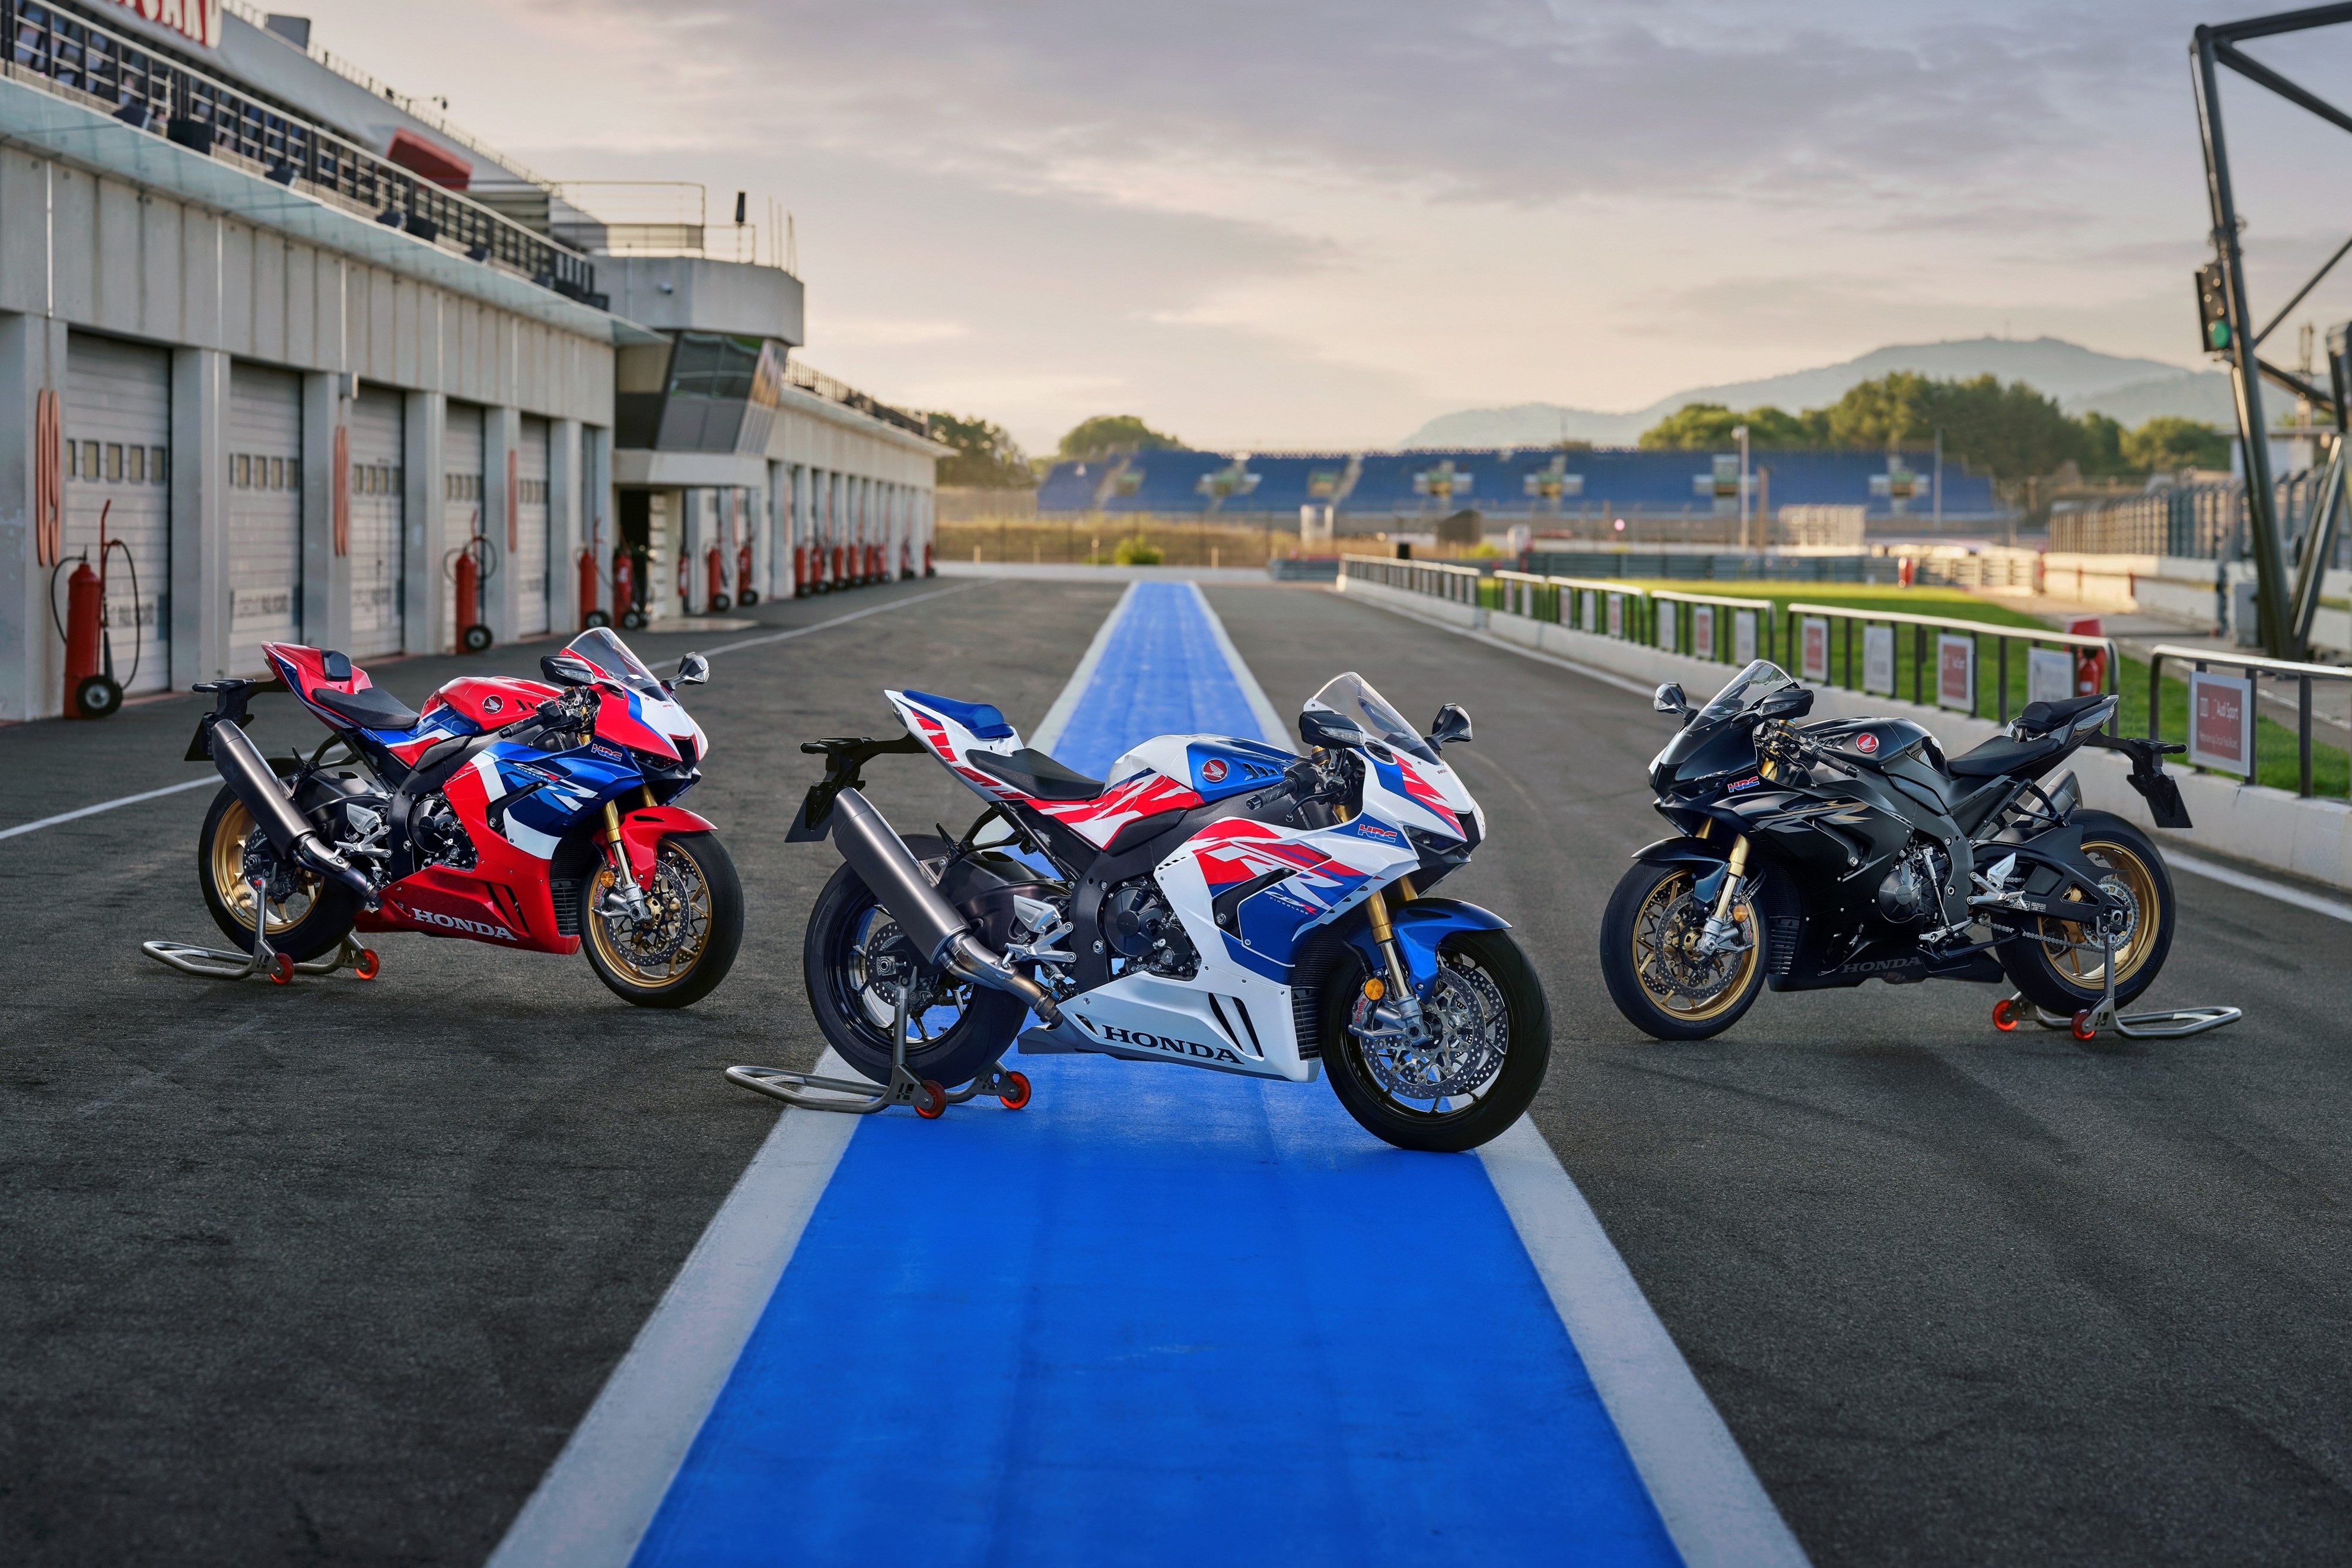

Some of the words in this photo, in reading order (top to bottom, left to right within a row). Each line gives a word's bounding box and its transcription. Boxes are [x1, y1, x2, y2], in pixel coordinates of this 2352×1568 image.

[591, 744, 623, 762] HRC
[1727, 776, 1760, 793] HRC
[1357, 823, 1398, 843] HRC
[1264, 891, 1319, 916] CBR
[1269, 897, 1309, 915] FIREBLADE
[412, 907, 518, 941] HONDA
[1841, 956, 1923, 974] HONDA
[1355, 998, 1366, 1022] brembo
[1102, 1024, 1245, 1065] HONDA
